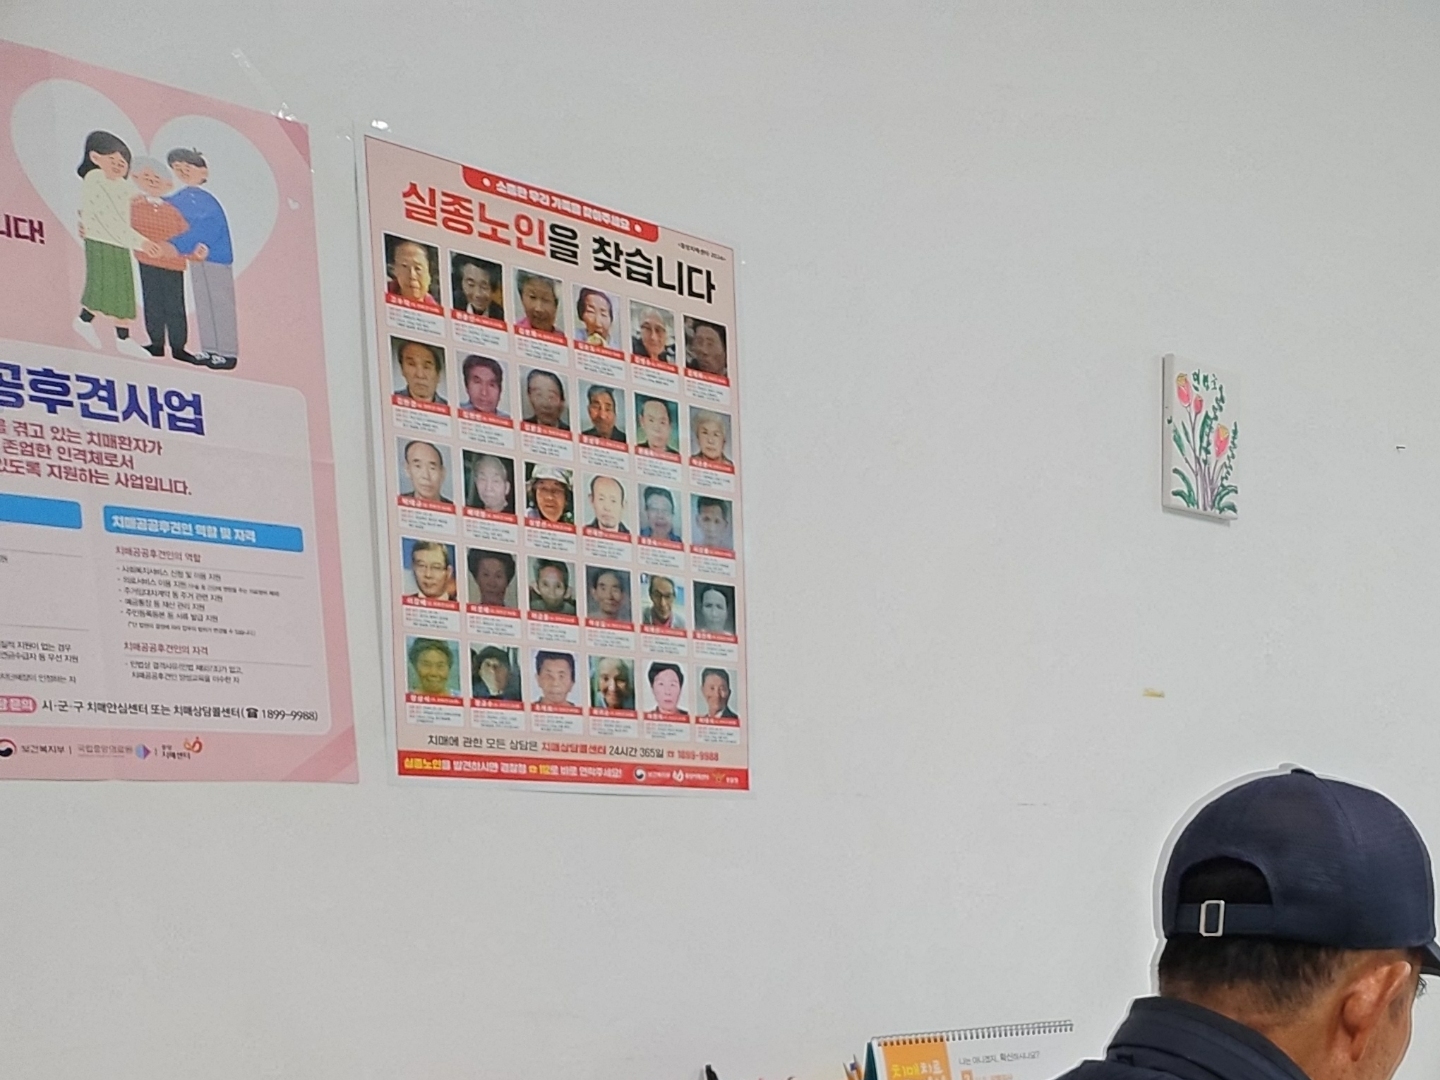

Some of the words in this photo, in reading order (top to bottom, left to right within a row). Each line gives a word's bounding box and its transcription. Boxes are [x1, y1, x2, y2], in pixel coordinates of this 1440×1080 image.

[402, 182, 579, 266] 실종노인을
[592, 236, 716, 304] 찾습니다
[13, 420, 44, 440] 겪고
[51, 426, 81, 445] 있는
[87, 431, 162, 455] 치매환자가
[58, 446, 134, 470] 인격체로서
[47, 463, 110, 486] 지원하는
[115, 471, 192, 495] 사업입니다.
[87, 702, 148, 715] 치매안심센터
[151, 704, 171, 716] 또는
[427, 735, 459, 747] 치매에
[462, 736, 483, 748] 관한
[486, 738, 506, 749] 모든
[509, 740, 538, 751] 상담은
[609, 745, 638, 758] 24시간
[640, 747, 664, 759] 365일
